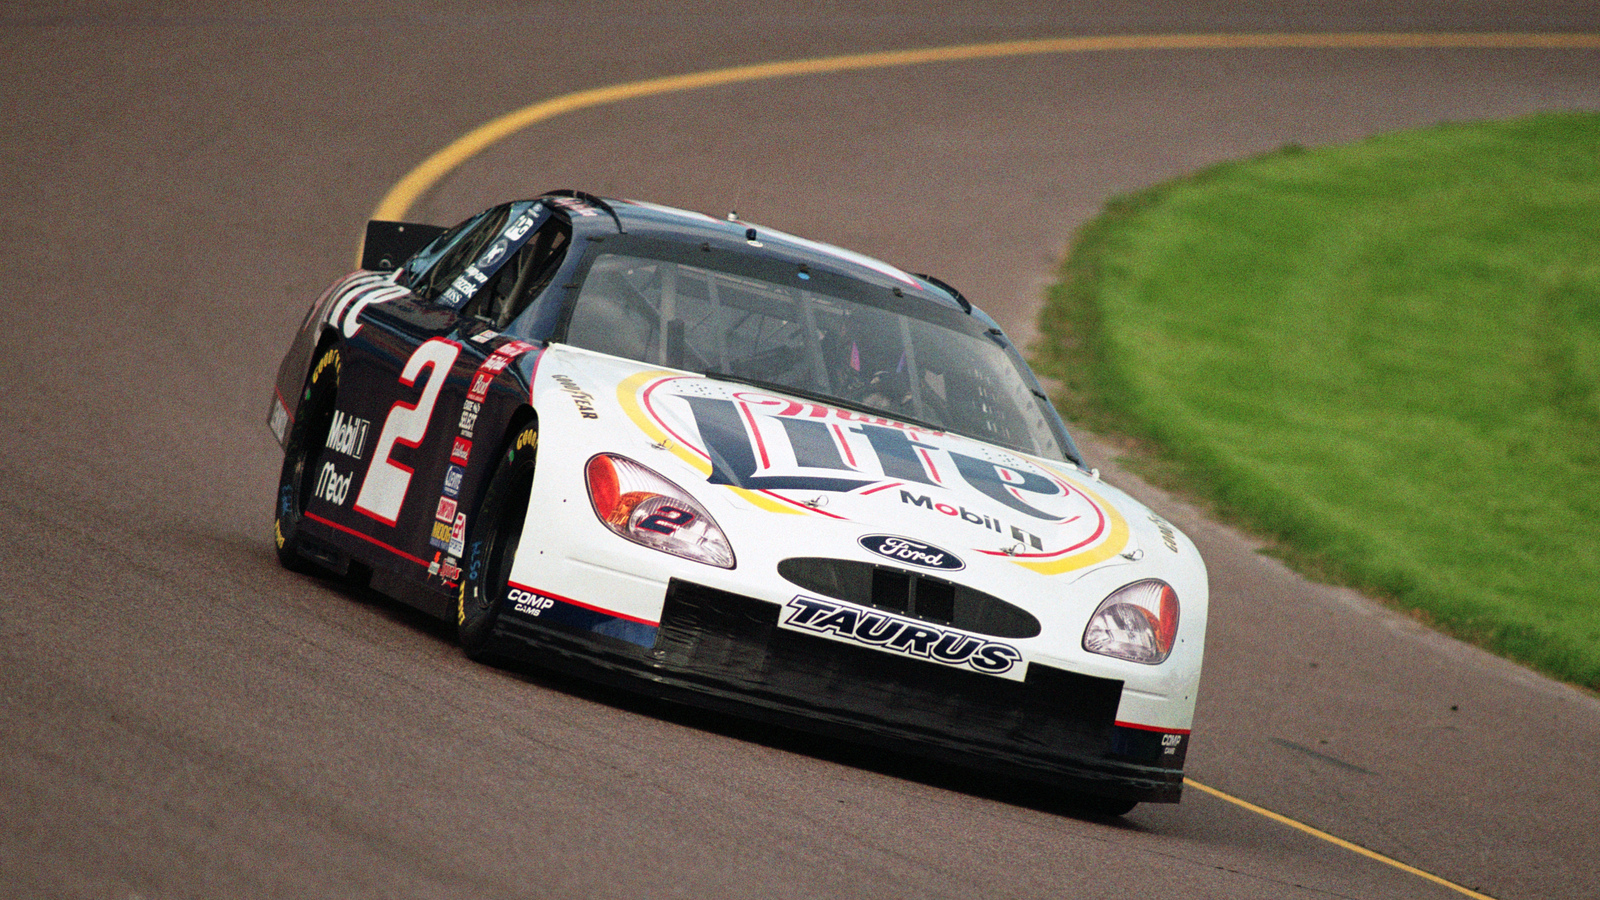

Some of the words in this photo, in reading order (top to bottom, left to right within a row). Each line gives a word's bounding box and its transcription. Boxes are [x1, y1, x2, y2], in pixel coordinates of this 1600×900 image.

[472, 374, 493, 396] Bud
[552, 374, 598, 420] GOODYEAR
[325, 410, 360, 456] Mobil
[354, 421, 368, 457] 1
[353, 336, 463, 527] 2
[667, 394, 1074, 523] Lite
[431, 521, 452, 543] MOOG
[636, 506, 695, 535] 2
[899, 490, 1002, 533] Mobil
[1010, 525, 1044, 552] 1
[879, 537, 943, 567] Ford
[507, 589, 554, 610] COMP
[514, 603, 541, 617] CAMS
[785, 595, 1022, 674] TAURUS
[1161, 734, 1182, 746] COMP
